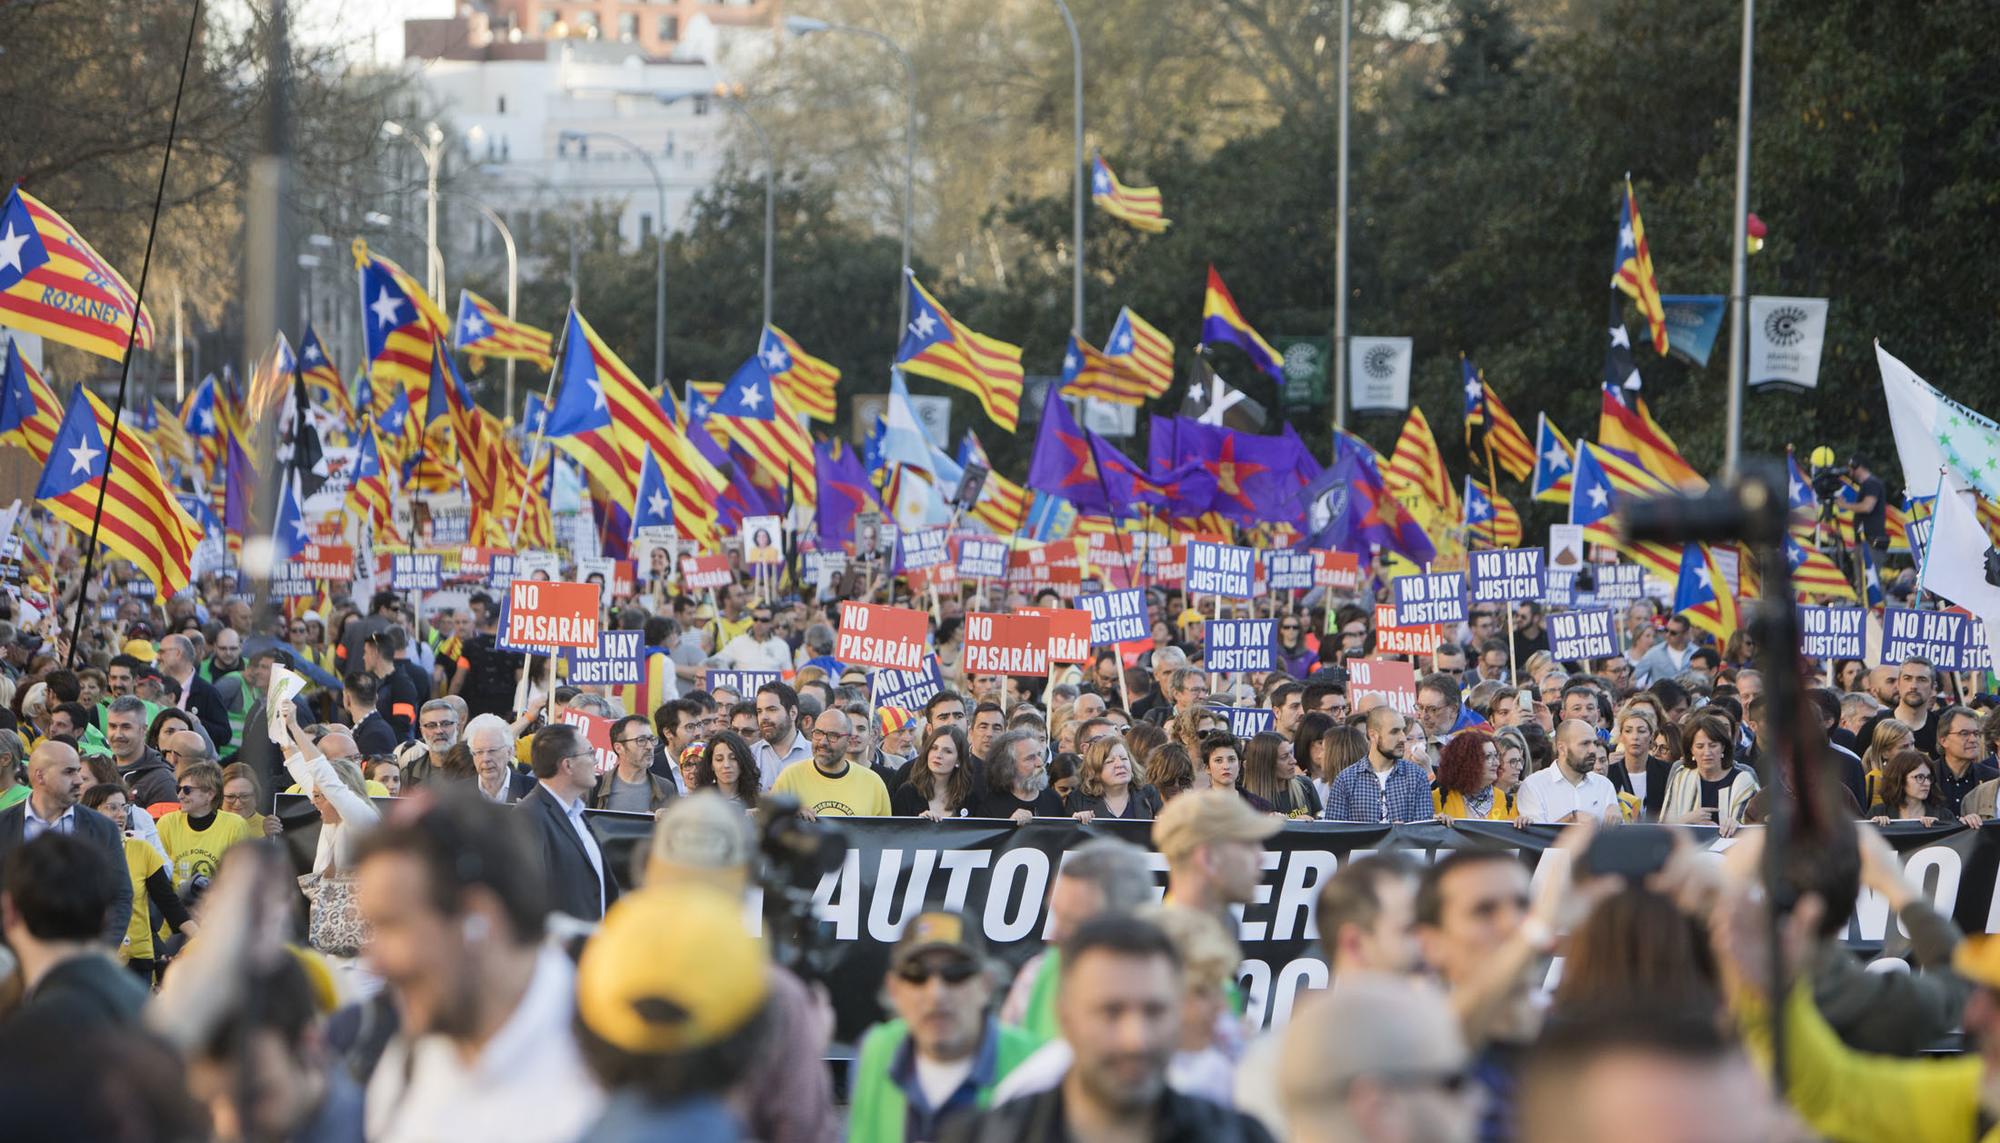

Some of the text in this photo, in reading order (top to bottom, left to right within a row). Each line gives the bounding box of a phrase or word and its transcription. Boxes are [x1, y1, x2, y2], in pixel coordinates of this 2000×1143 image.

[902, 534, 920, 552] NO
[920, 529, 943, 550] HAY
[963, 541, 1006, 561] NO HAY
[396, 554, 413, 571] NO
[415, 554, 437, 571] HAY
[462, 549, 477, 562] NO
[494, 556, 511, 571] NO
[1158, 547, 1172, 562] NO
[1194, 544, 1250, 573] NO HAY
[1273, 555, 1313, 572] NO HAY
[1478, 551, 1538, 577] NO HAY
[305, 561, 350, 578] PASARÁN
[1598, 565, 1641, 583] NO HAY
[1190, 569, 1247, 595] JUSTÍCIA
[1402, 574, 1460, 601] NO HAY
[1475, 575, 1539, 600] JUSTÍCIA
[514, 585, 539, 610] NO
[1082, 590, 1141, 621] NO HAY
[843, 606, 869, 632] NO
[1378, 608, 1397, 628] NO
[1401, 599, 1462, 623] JUSTÍCIA
[1804, 610, 1862, 634] NO HAY
[513, 611, 595, 644] PASARÁN
[968, 617, 992, 641] NO
[1213, 622, 1272, 646] NO HAY
[1553, 611, 1608, 639] NO HAY
[1892, 612, 1919, 639] NO
[1923, 614, 1962, 643] HAY
[605, 634, 639, 657] HAY
[839, 635, 922, 668] PASARÁN
[966, 642, 1046, 672] PASARÁN
[1554, 635, 1612, 661] JUSTÍCIA
[1801, 634, 1860, 657] JUSTÍCIA
[1885, 640, 1955, 667] JUSTÍCIA
[1208, 646, 1270, 670] JUSTÍCIA
[573, 660, 639, 682] JUSTÍCIA
[877, 658, 935, 696] NO HAY
[1351, 663, 1371, 684] NO
[1233, 712, 1270, 738] HAY
